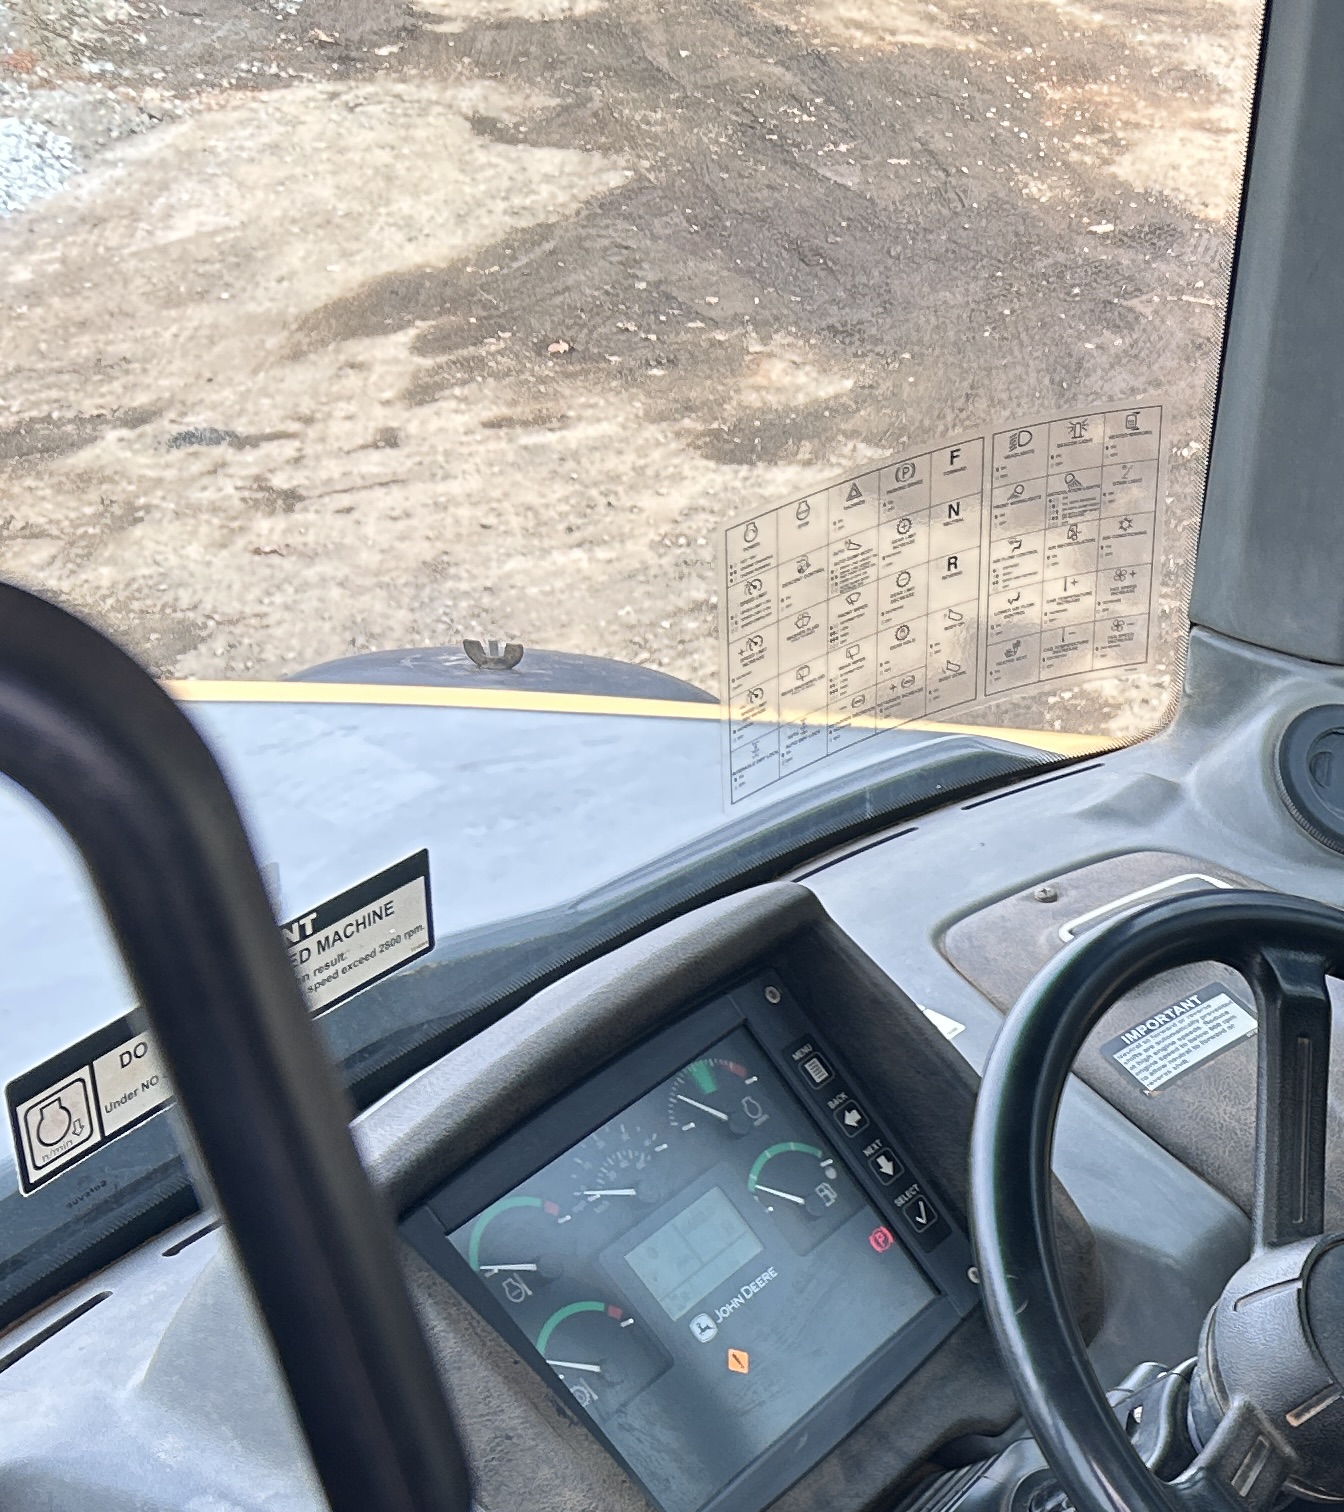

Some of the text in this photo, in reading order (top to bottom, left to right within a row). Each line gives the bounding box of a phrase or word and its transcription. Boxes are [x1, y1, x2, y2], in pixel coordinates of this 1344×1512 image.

[949, 447, 960, 466] F
[947, 500, 960, 519] N
[946, 553, 957, 572] R
[315, 898, 395, 956] MACHINE
[306, 969, 339, 995] speed
[340, 948, 376, 975] exceed
[403, 921, 425, 941] rpm.
[312, 950, 347, 977] result.
[1122, 995, 1199, 1043] IMPORTANT
[1151, 1023, 1176, 1039] forward
[1186, 1003, 1210, 1018] reverse
[1156, 1019, 1198, 1045] automatically
[1136, 1054, 1153, 1065] high
[1153, 1041, 1176, 1055] engine
[1203, 1010, 1228, 1026] Reduce
[119, 1041, 149, 1069] DO
[792, 1043, 813, 1061] MENU
[1134, 1060, 1158, 1076] engine
[1158, 1047, 1179, 1060] speed
[1188, 1030, 1208, 1043] below
[1148, 1063, 1167, 1075] allow
[1168, 1049, 1191, 1064] neutral
[1200, 1028, 1225, 1044] forward
[104, 1074, 160, 1114] Under NO
[827, 1092, 848, 1109] BACK
[39, 1138, 74, 1162] n/min
[863, 1139, 883, 1157] NEXT
[894, 1183, 921, 1207] SELECT
[714, 1267, 778, 1323] JOHN DEERE
